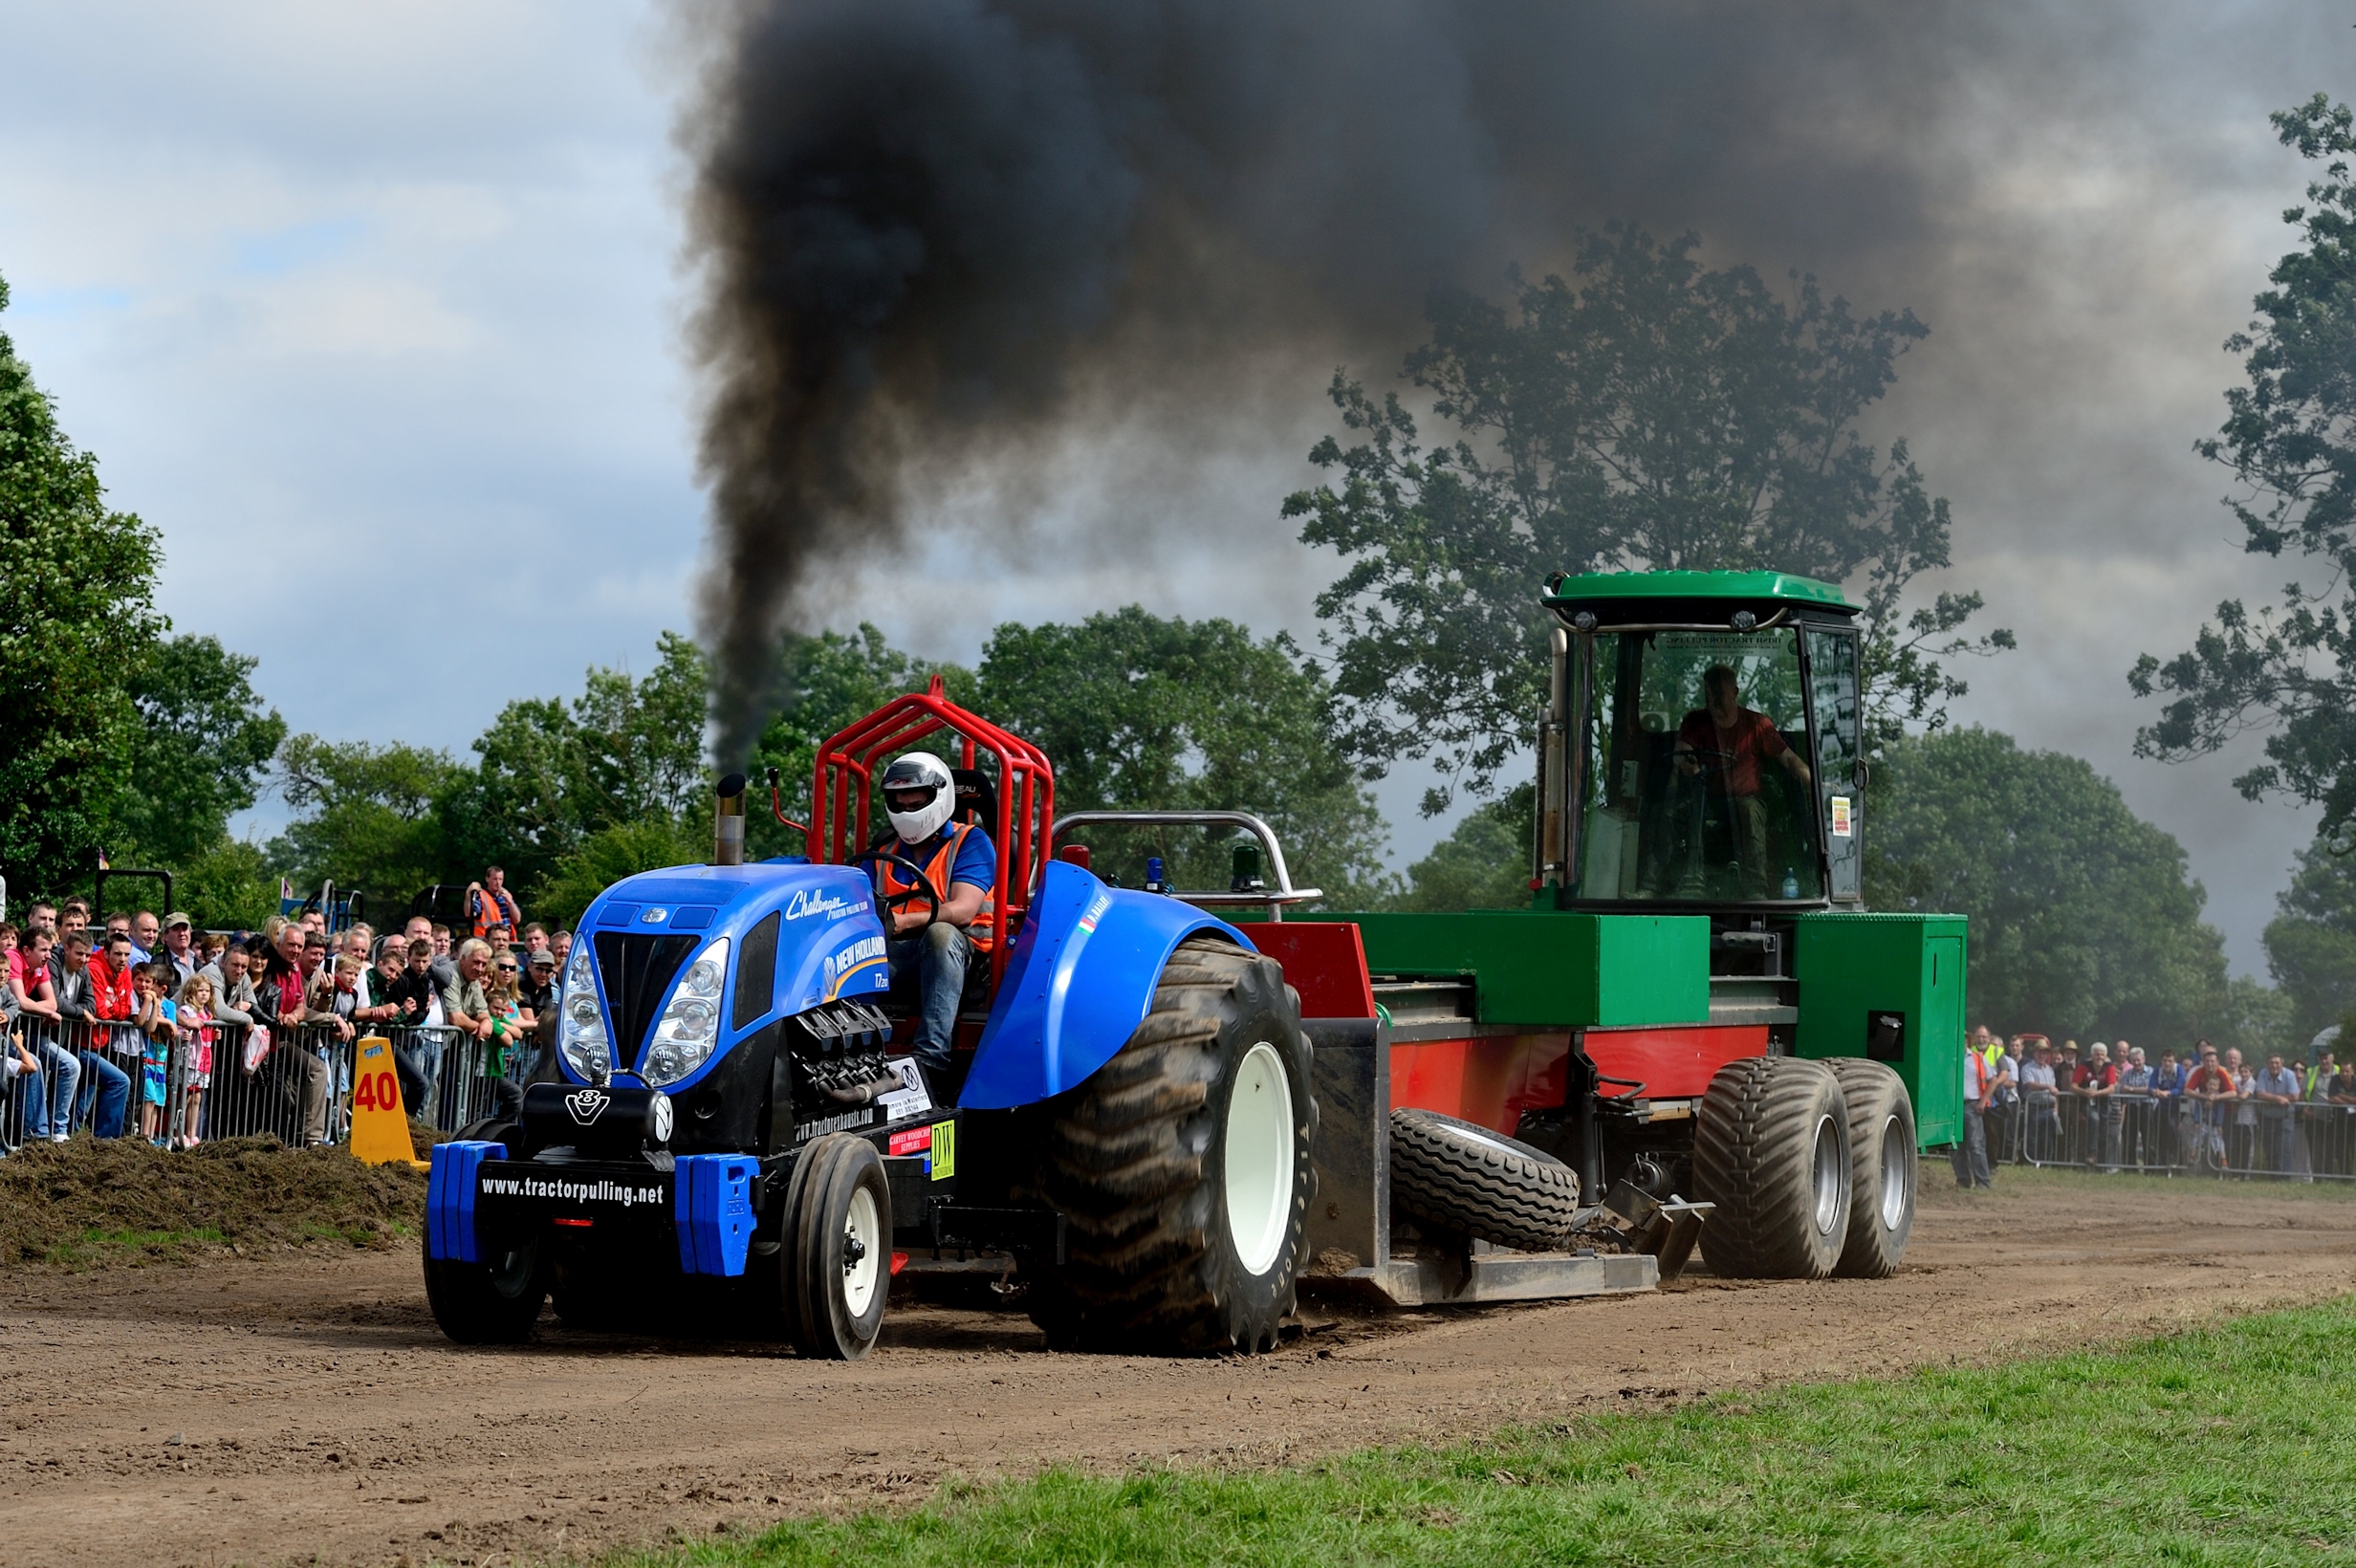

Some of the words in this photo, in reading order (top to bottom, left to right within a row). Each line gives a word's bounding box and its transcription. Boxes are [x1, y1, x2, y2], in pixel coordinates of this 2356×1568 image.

[786, 889, 848, 921] Challenger
[836, 945, 855, 974] NEW
[854, 936, 886, 963] HOLLAND
[355, 1072, 397, 1112] 40
[901, 1140, 921, 1152] SUPPLIES
[906, 1127, 931, 1142] WOODCHIP
[933, 1123, 952, 1166] DW
[482, 1177, 664, 1207] www.tractorpulling.net
